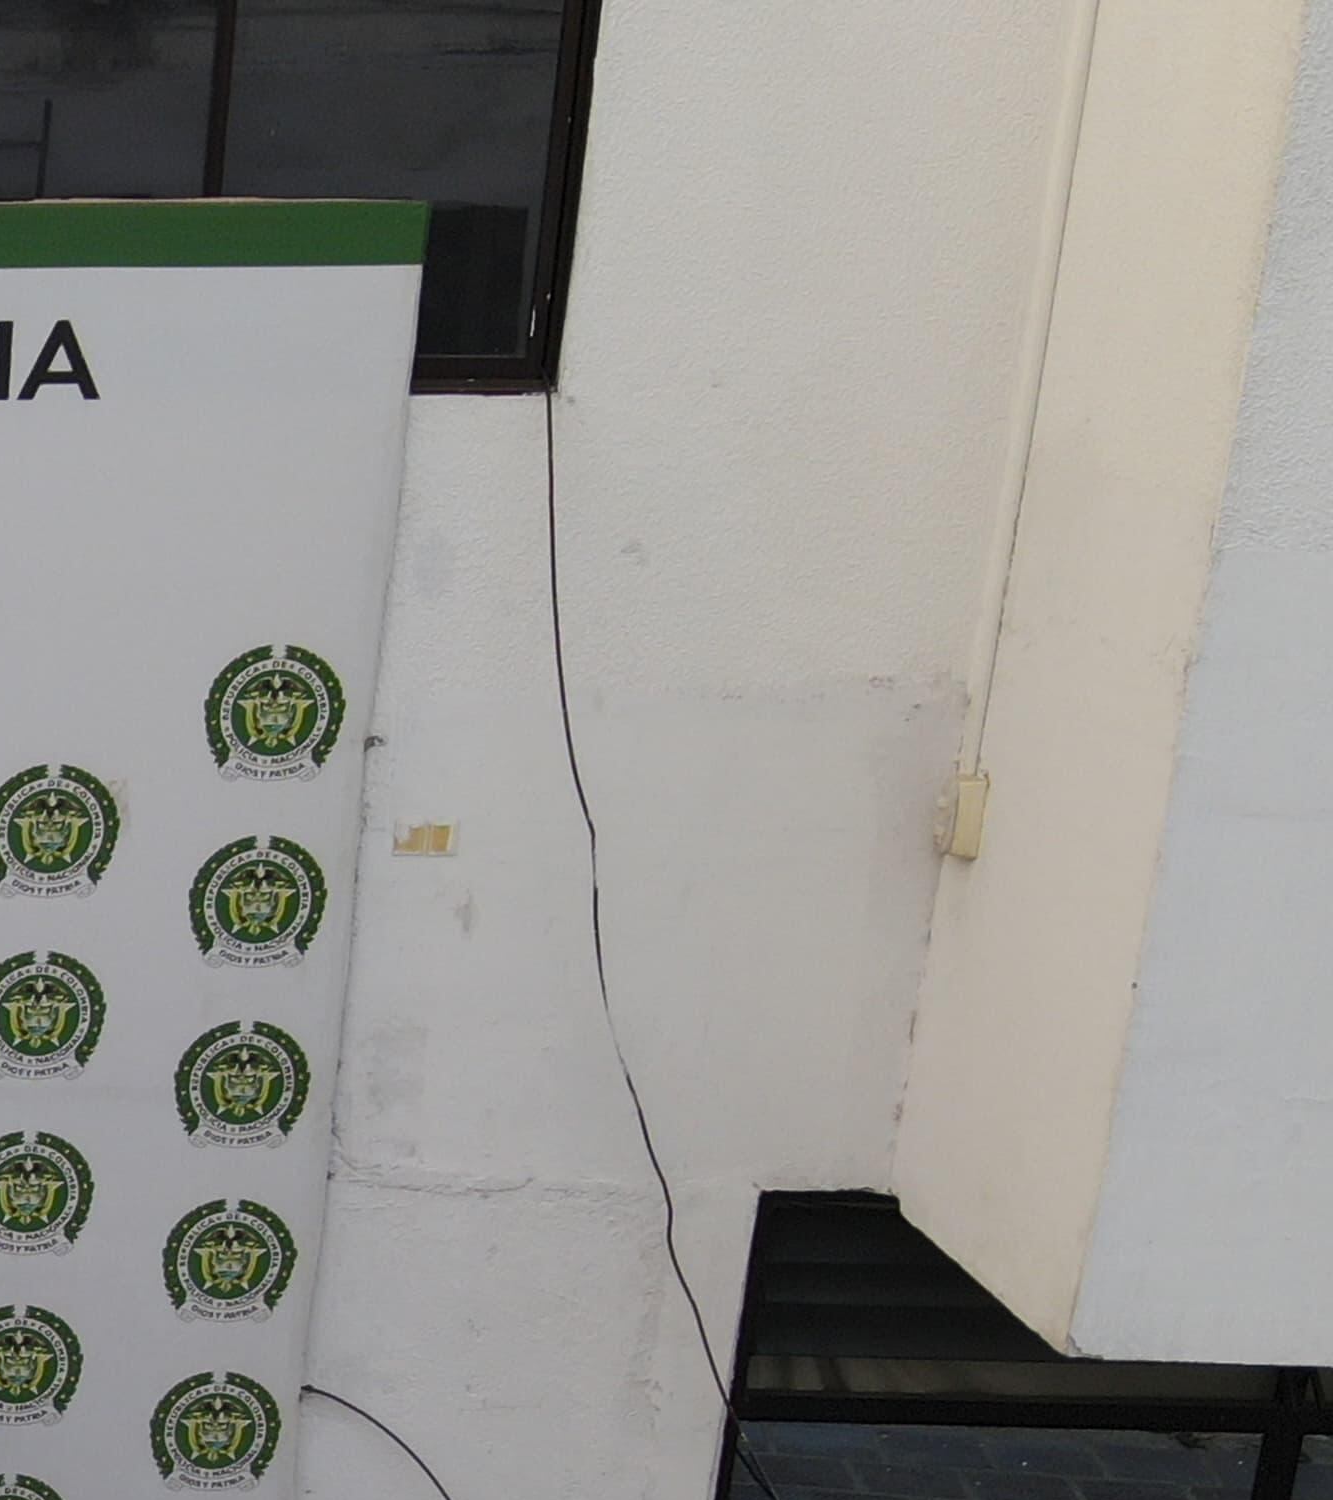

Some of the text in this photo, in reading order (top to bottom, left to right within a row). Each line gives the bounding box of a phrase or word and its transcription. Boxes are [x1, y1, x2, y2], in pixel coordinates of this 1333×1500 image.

[272, 660, 288, 669] DE
[297, 667, 327, 721] COLOMBIA
[48, 779, 63, 788] DE
[72, 786, 102, 839] COLOMBIA
[256, 850, 271, 859] DE
[280, 858, 310, 910] COLOMBIA
[35, 965, 50, 974] DE
[59, 972, 89, 1023] COLOMBIA
[24, 1145, 38, 1153] DE
[48, 1152, 77, 1201] COLOMBIA
[226, 1212, 241, 1221] DE
[250, 1219, 279, 1269] COLOMBIA
